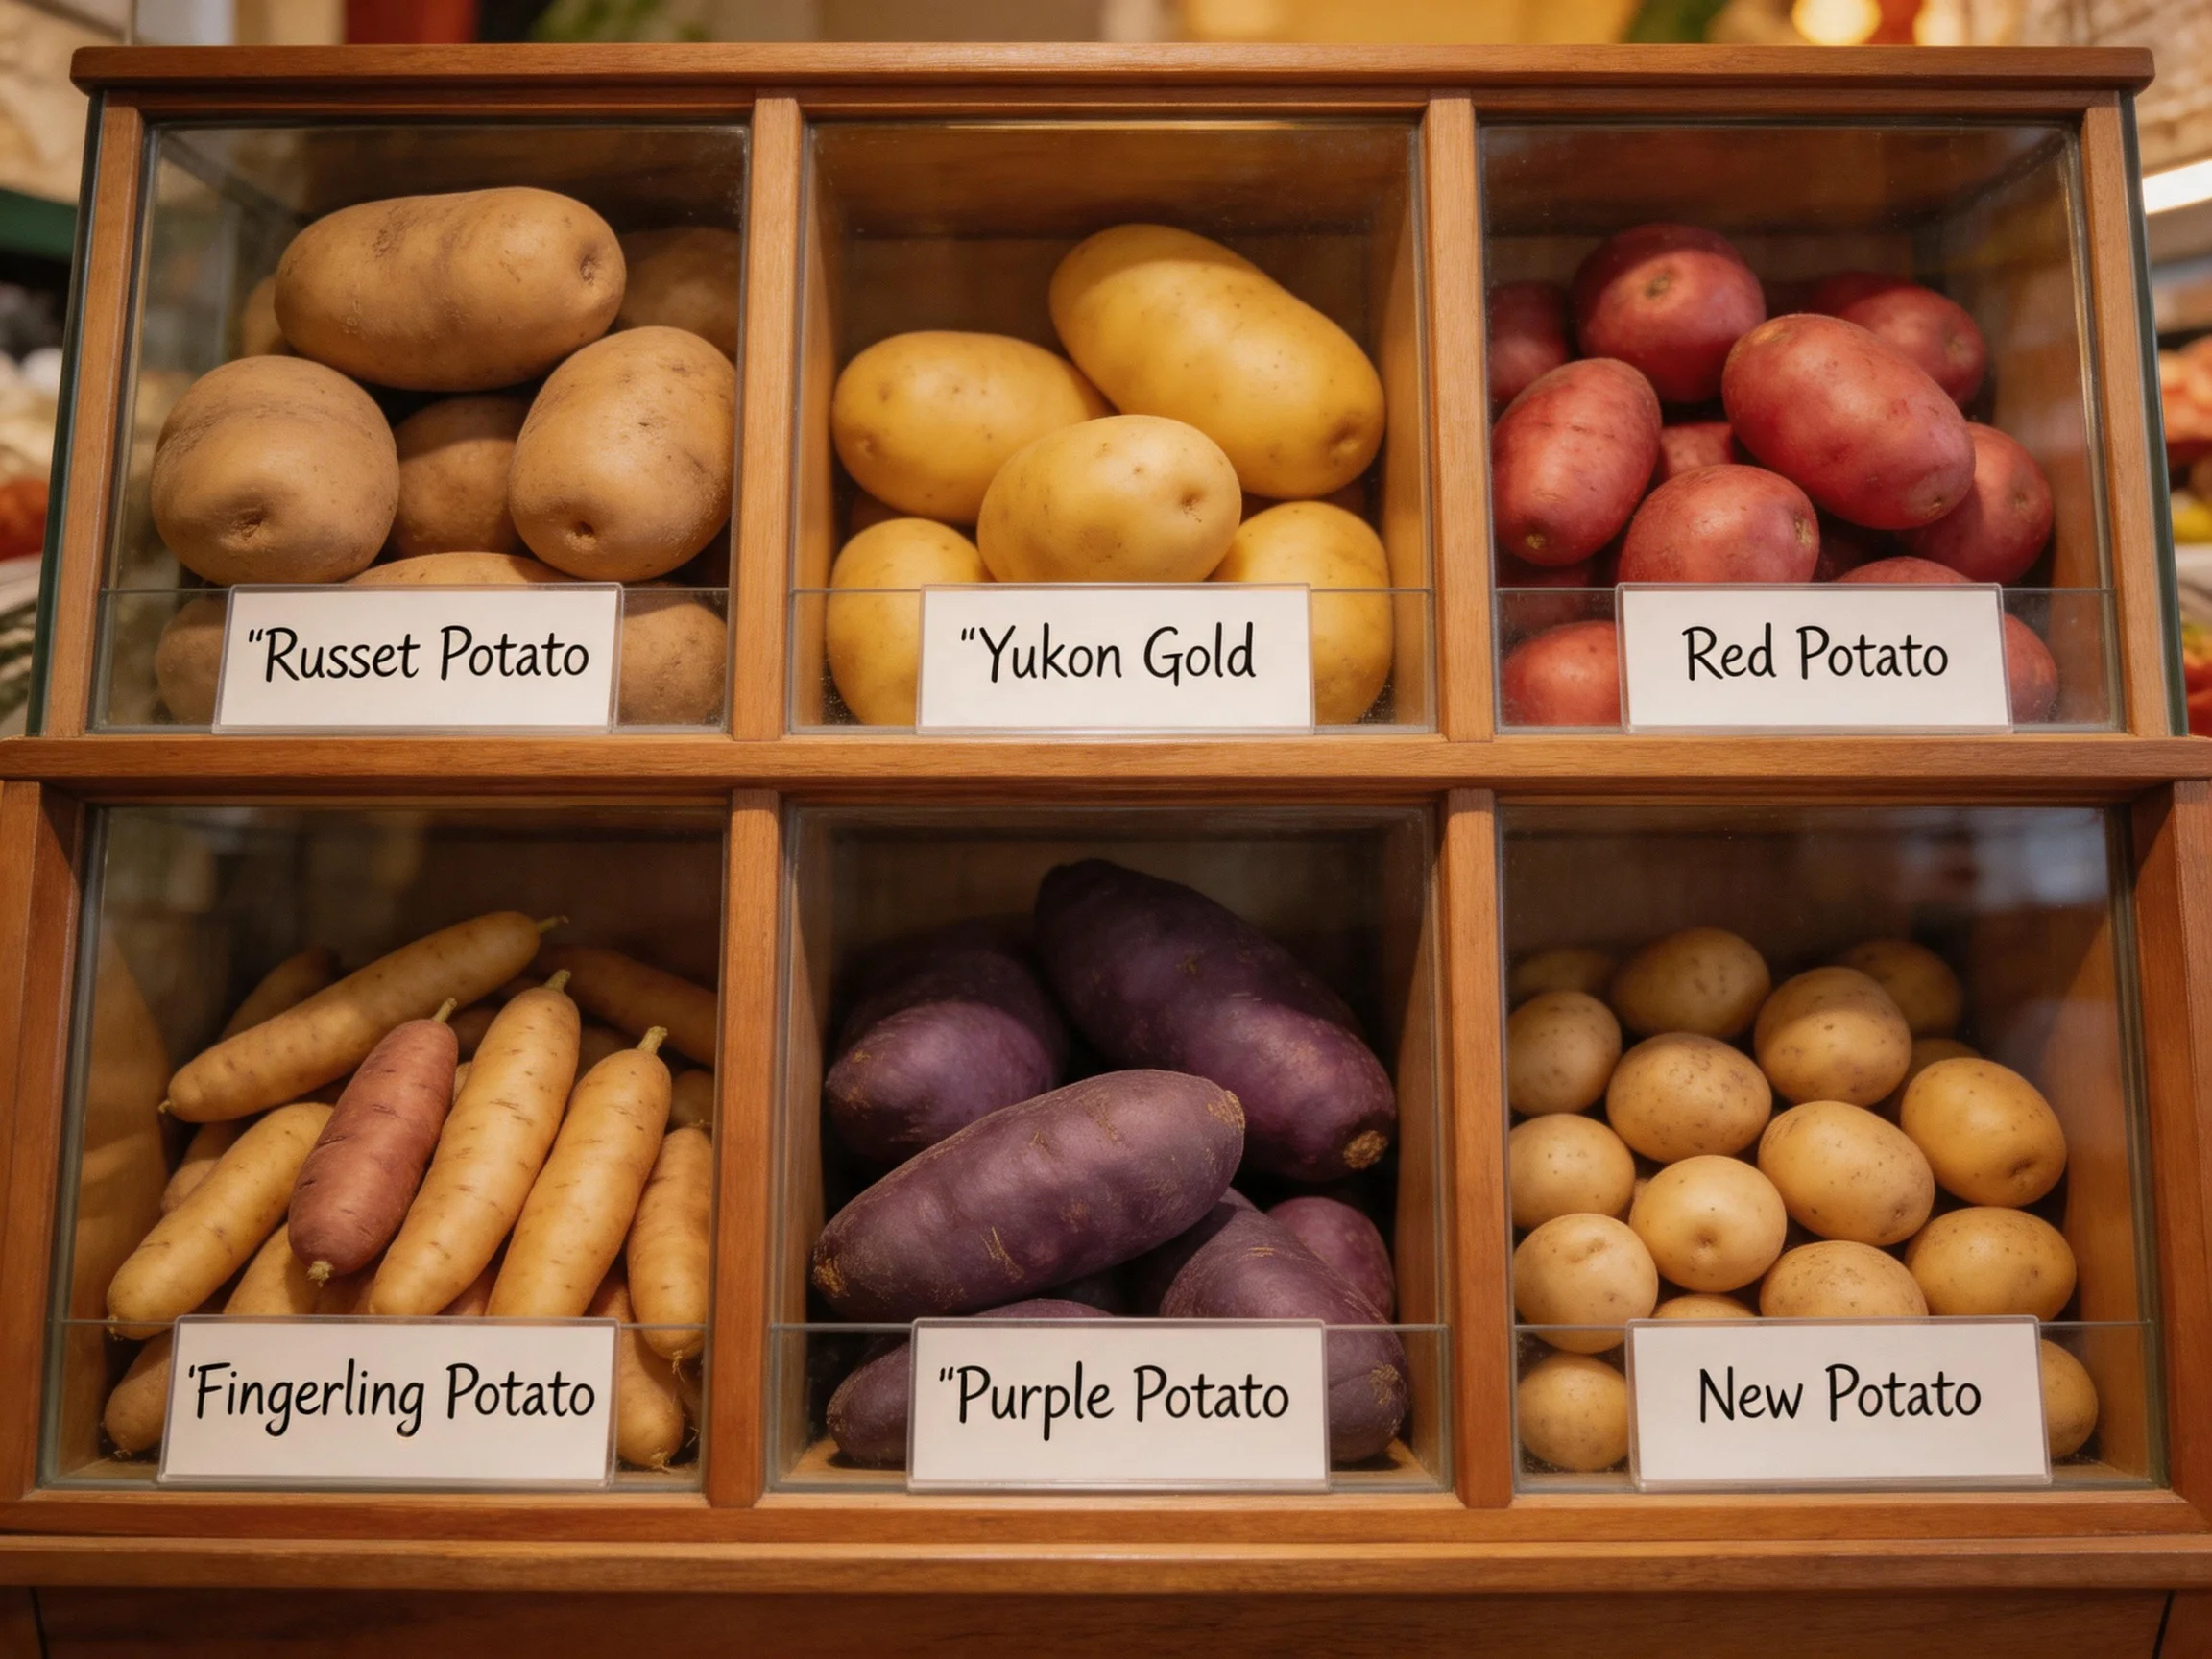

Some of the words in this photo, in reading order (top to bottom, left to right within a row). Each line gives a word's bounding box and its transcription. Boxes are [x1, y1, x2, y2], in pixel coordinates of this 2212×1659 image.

[440, 624, 589, 682] Potato
[1143, 621, 1257, 687] Gold
[1681, 622, 1777, 682] Red
[1795, 625, 1949, 680] Potato
[445, 1362, 595, 1420] Potato
[1133, 1364, 1289, 1423] Potato
[1699, 1365, 1804, 1424] New
[1824, 1363, 1982, 1422] Potato
